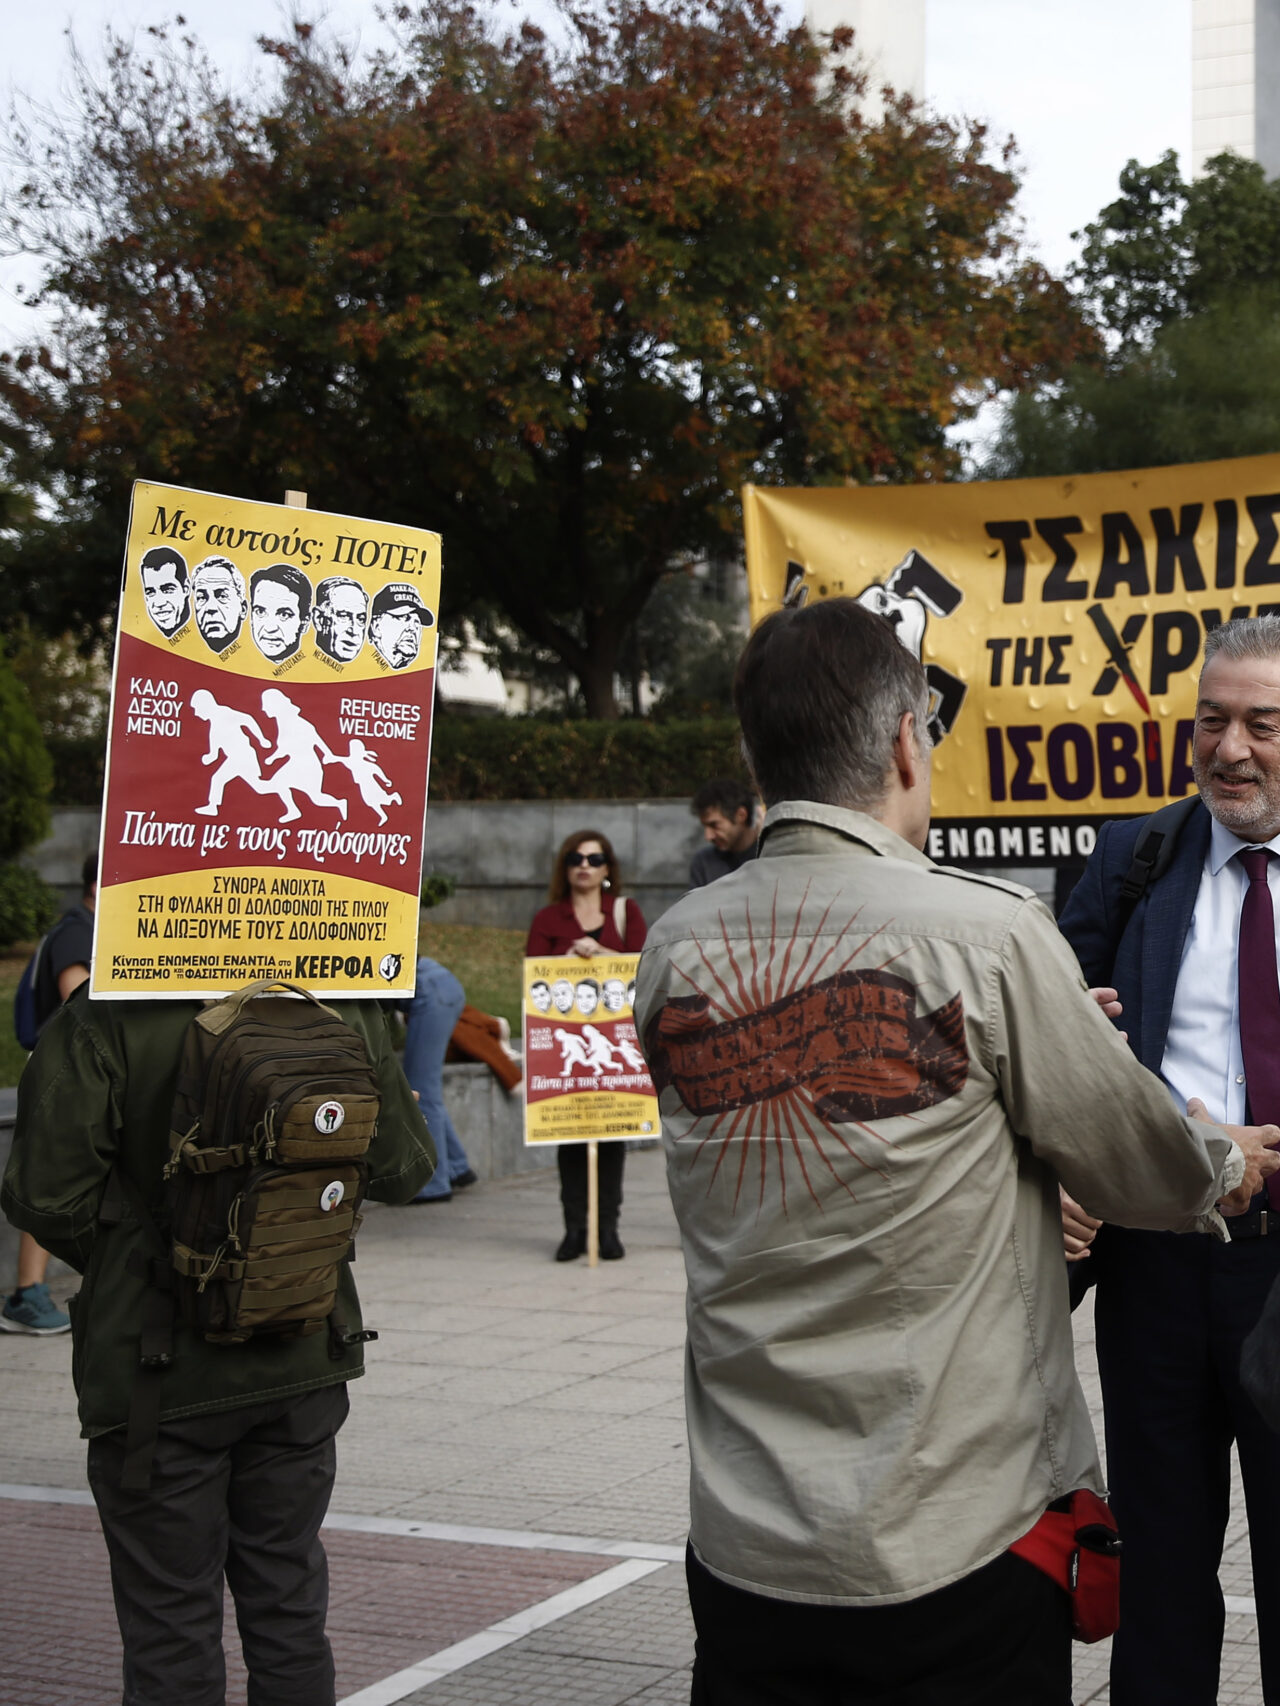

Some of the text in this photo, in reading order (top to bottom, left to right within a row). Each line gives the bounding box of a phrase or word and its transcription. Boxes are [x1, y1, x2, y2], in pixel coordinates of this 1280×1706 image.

[149, 506, 427, 575] Με αυτούς; ΠΟΤΕ!
[986, 635, 1073, 687] ΤΗΣ
[130, 677, 178, 698] ΚΑΛΟ
[127, 698, 182, 718] ΔΕΧΟΥ
[340, 698, 421, 722] REFUGEES
[127, 717, 181, 737] ΜΕΝΟΙ
[339, 717, 416, 741] WELCOME
[120, 810, 411, 865] Πάντα με τους πρόσφυγες
[928, 825, 1098, 857] ΕΝΩΜΕΝΟ
[213, 876, 326, 896] ΣΥΝΟΡΑ ΑΝΟΙΧΤΑ
[138, 895, 389, 918] ΣΤΗ ΦΥΛΑΚΗ ΟΙ ΔΟΛΟΦΟΝΟΙ ΤΗΣ ΠΥΛΟΥ
[138, 918, 387, 941] ΝΑ ΔΙΩΞΟΥΜΕ ΤΟΥΣ ΔΟΛΟΦΟΝΟΥΣ!
[112, 955, 154, 967] Κίνηση
[158, 956, 219, 966] ΕΝΩΜΕΝΟΙ
[224, 956, 276, 966] ΕΝΑΝΤΙΑ
[295, 955, 373, 979] ΚΕΕΡΦΑ
[112, 968, 170, 979] ΡΑΤΣΙΣΜΟ
[185, 968, 246, 979] ΦΑΣΙΣΤΙΚΗ
[249, 968, 292, 979] ΑΠΕΙΛΗ
[836, 984, 909, 1019] THE
